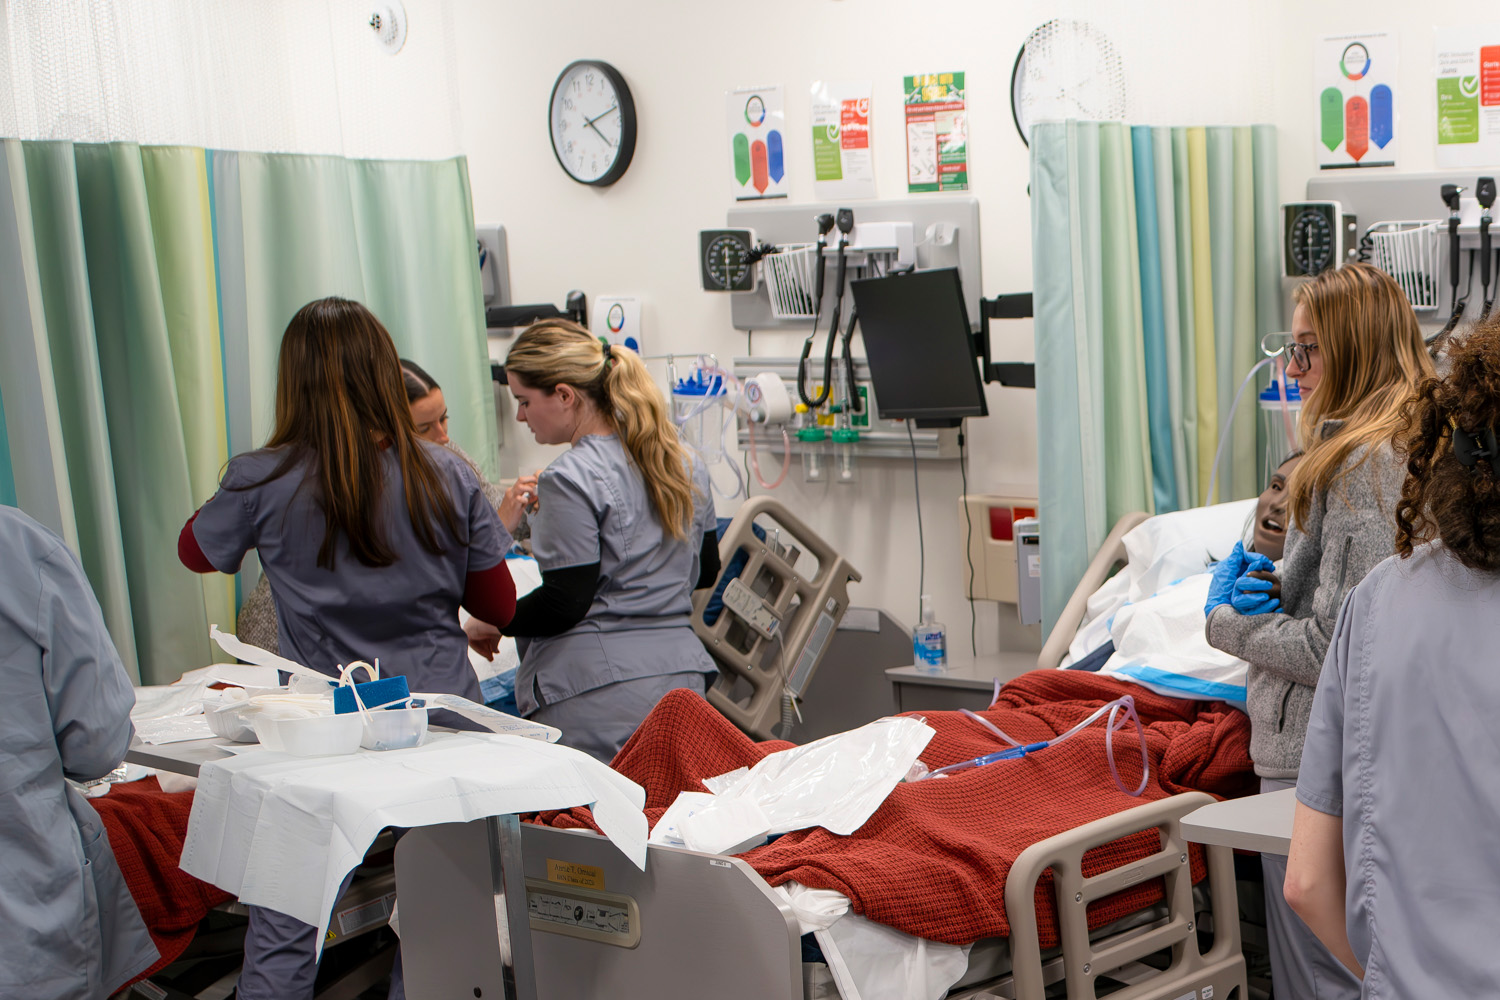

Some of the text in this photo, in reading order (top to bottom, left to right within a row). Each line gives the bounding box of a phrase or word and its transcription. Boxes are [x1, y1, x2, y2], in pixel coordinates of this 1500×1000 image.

[585, 74, 594, 86] 12
[600, 80, 604, 90] 1
[573, 81, 580, 93] 11
[564, 99, 573, 111] 10
[560, 120, 567, 132] 9
[567, 141, 573, 153] 8
[579, 156, 584, 168] 7
[591, 161, 597, 173] 6
